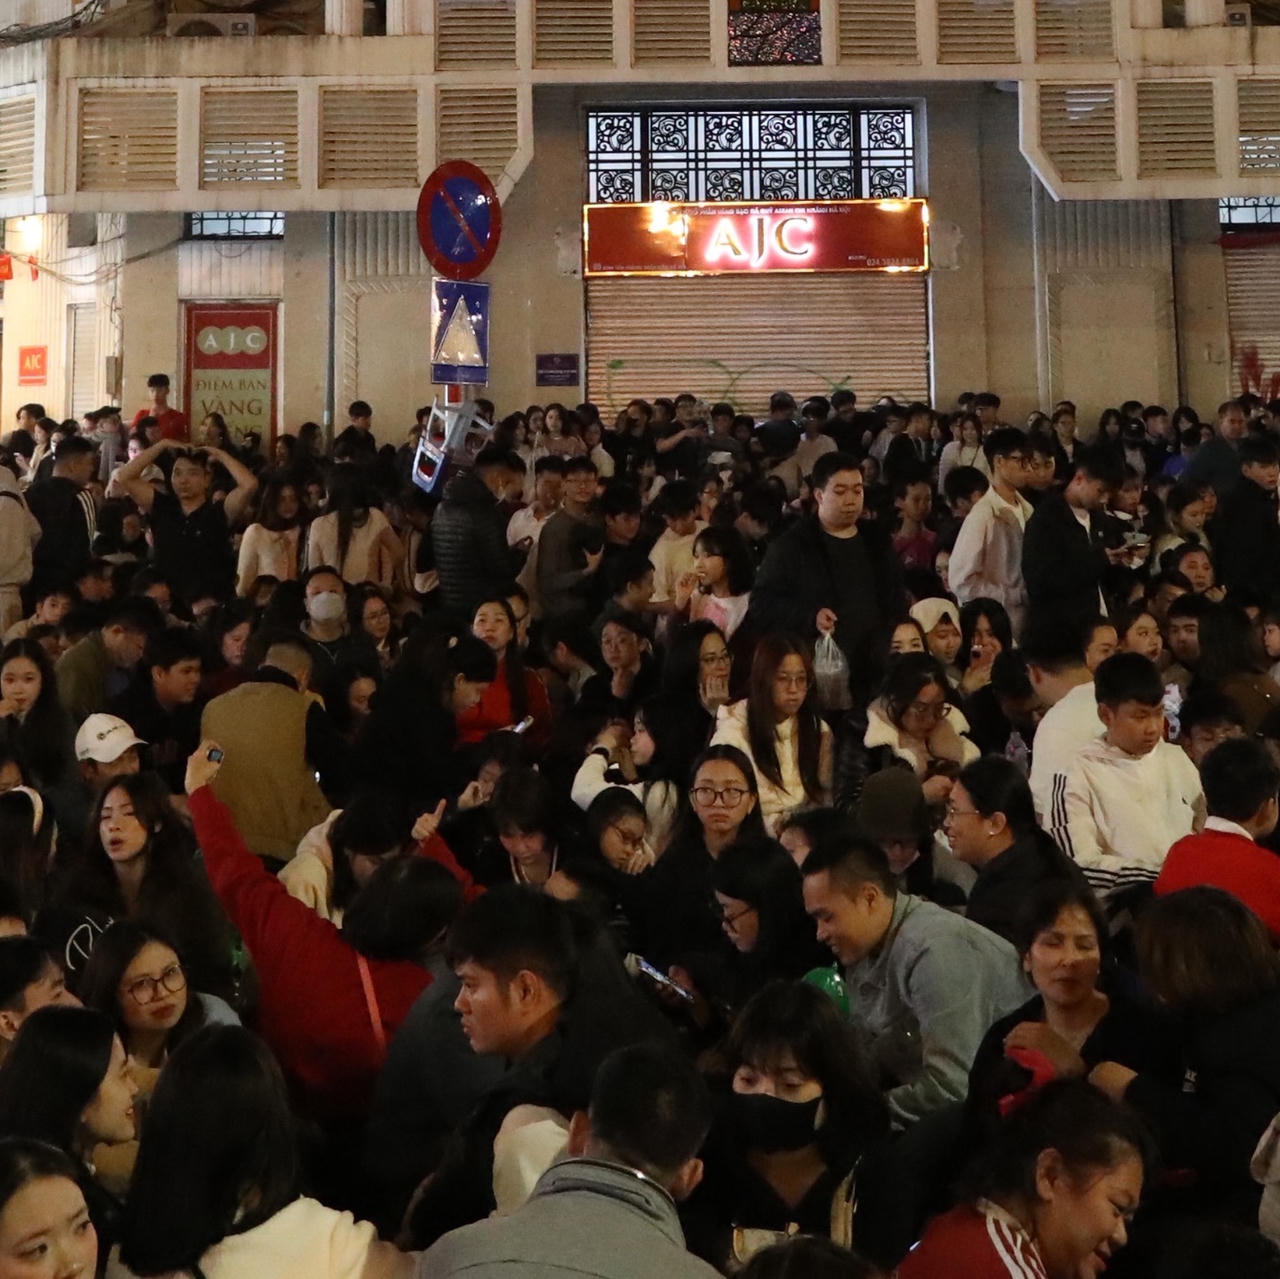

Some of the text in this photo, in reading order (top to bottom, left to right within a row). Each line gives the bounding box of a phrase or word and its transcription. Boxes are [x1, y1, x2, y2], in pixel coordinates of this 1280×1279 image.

[705, 217, 814, 267] AJC
[204, 332, 261, 350] AJC
[201, 395, 262, 416] VÀNG
